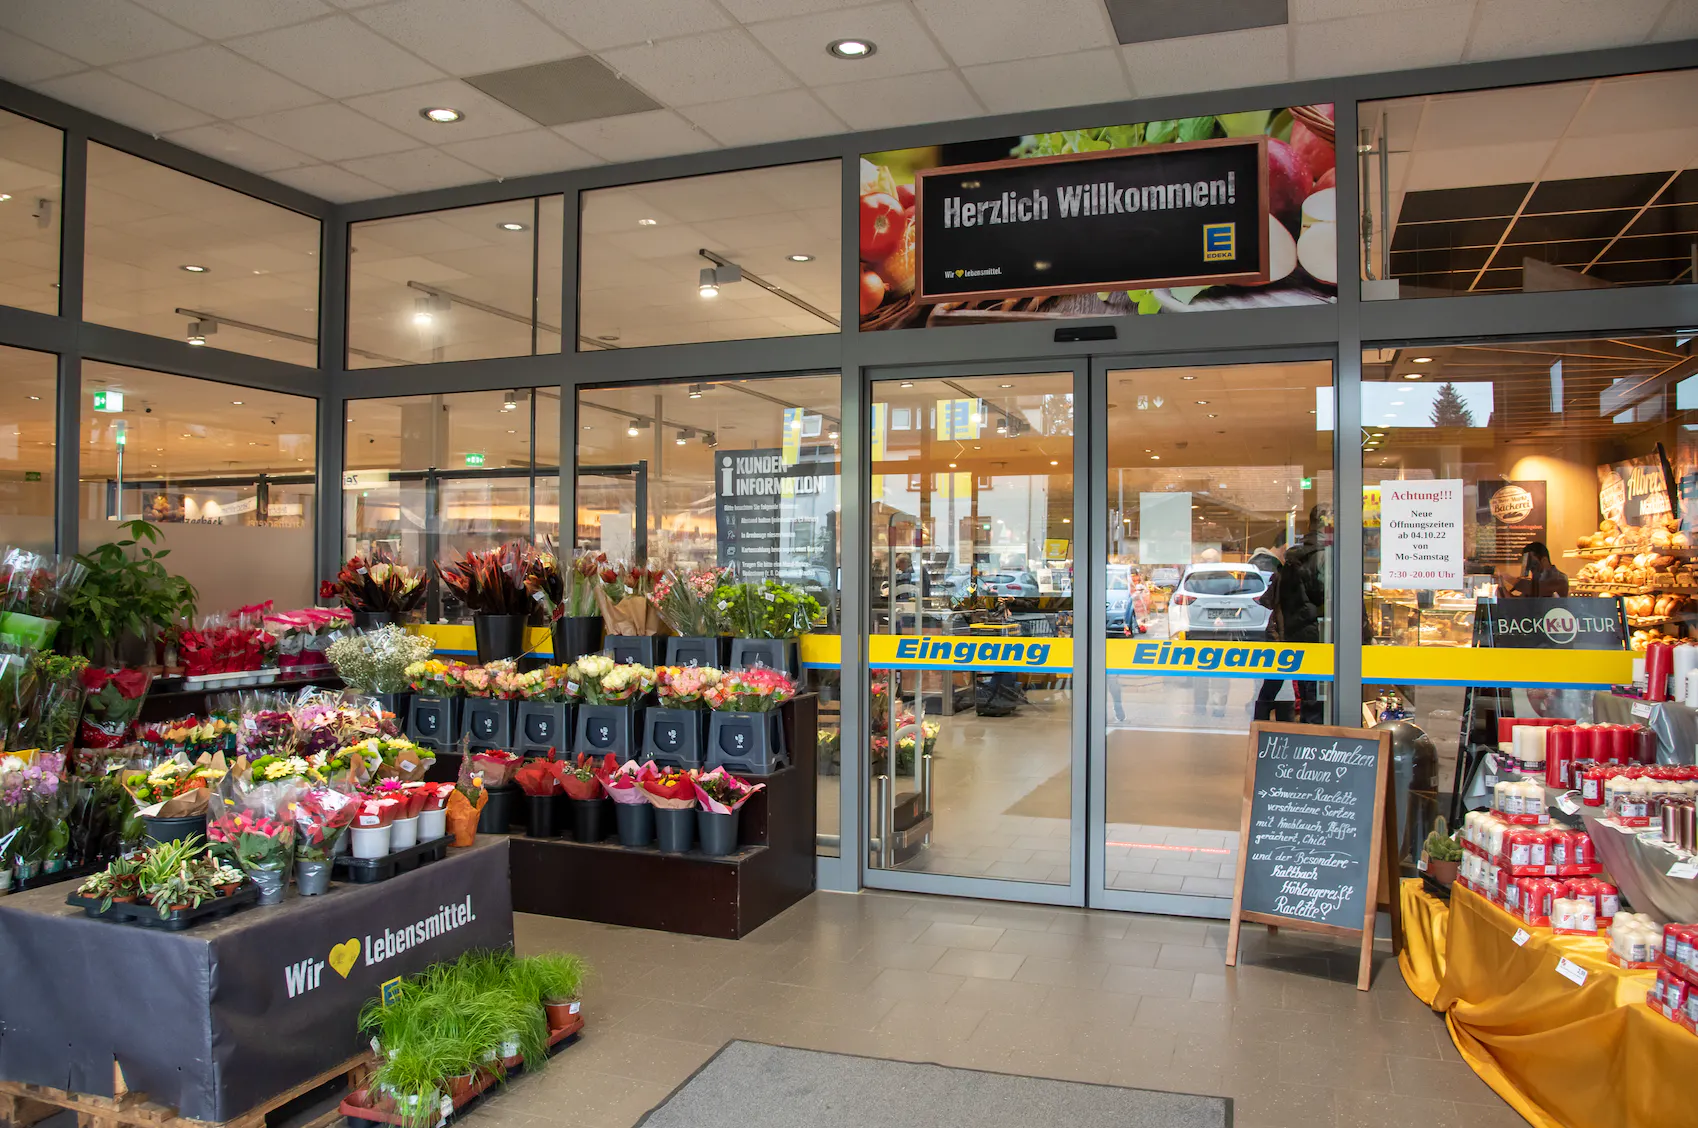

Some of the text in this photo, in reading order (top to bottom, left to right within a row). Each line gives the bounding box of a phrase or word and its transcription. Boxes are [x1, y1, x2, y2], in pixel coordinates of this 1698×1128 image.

[943, 171, 1236, 228] Herzlich Willkommen!
[944, 267, 1002, 279] Wir Lebensmittel.
[736, 456, 793, 475] KUNDEN-
[736, 476, 826, 496] INFORMATION!
[1390, 490, 1452, 503] Achtung!!!
[1410, 510, 1433, 518] Neue
[1389, 520, 1455, 530] Öffnungszeiten
[1397, 531, 1446, 539] ab 04.10.22
[1395, 553, 1450, 562] Mo-Samstag
[1388, 571, 1408, 579] 7:30
[1437, 571, 1456, 579] Uhr
[896, 637, 1051, 665] Eingang
[1132, 641, 1305, 673] Eingang
[1259, 736, 1375, 768] Mit uns schmelzen
[1275, 762, 1332, 783] Sie davon
[1268, 787, 1358, 806] Schweizer Raclette
[1267, 802, 1321, 815] verschiedene
[1256, 816, 1275, 828] mit
[1302, 834, 1328, 846] Chili
[1252, 850, 1273, 861] und
[1275, 852, 1293, 861] der
[1294, 852, 1350, 869] Besondere
[1270, 864, 1318, 880] Kaltbach
[1280, 880, 1354, 911] Höhlengereift
[1272, 896, 1320, 919] Raclette
[285, 894, 477, 999] Wir Lebensmittel.
